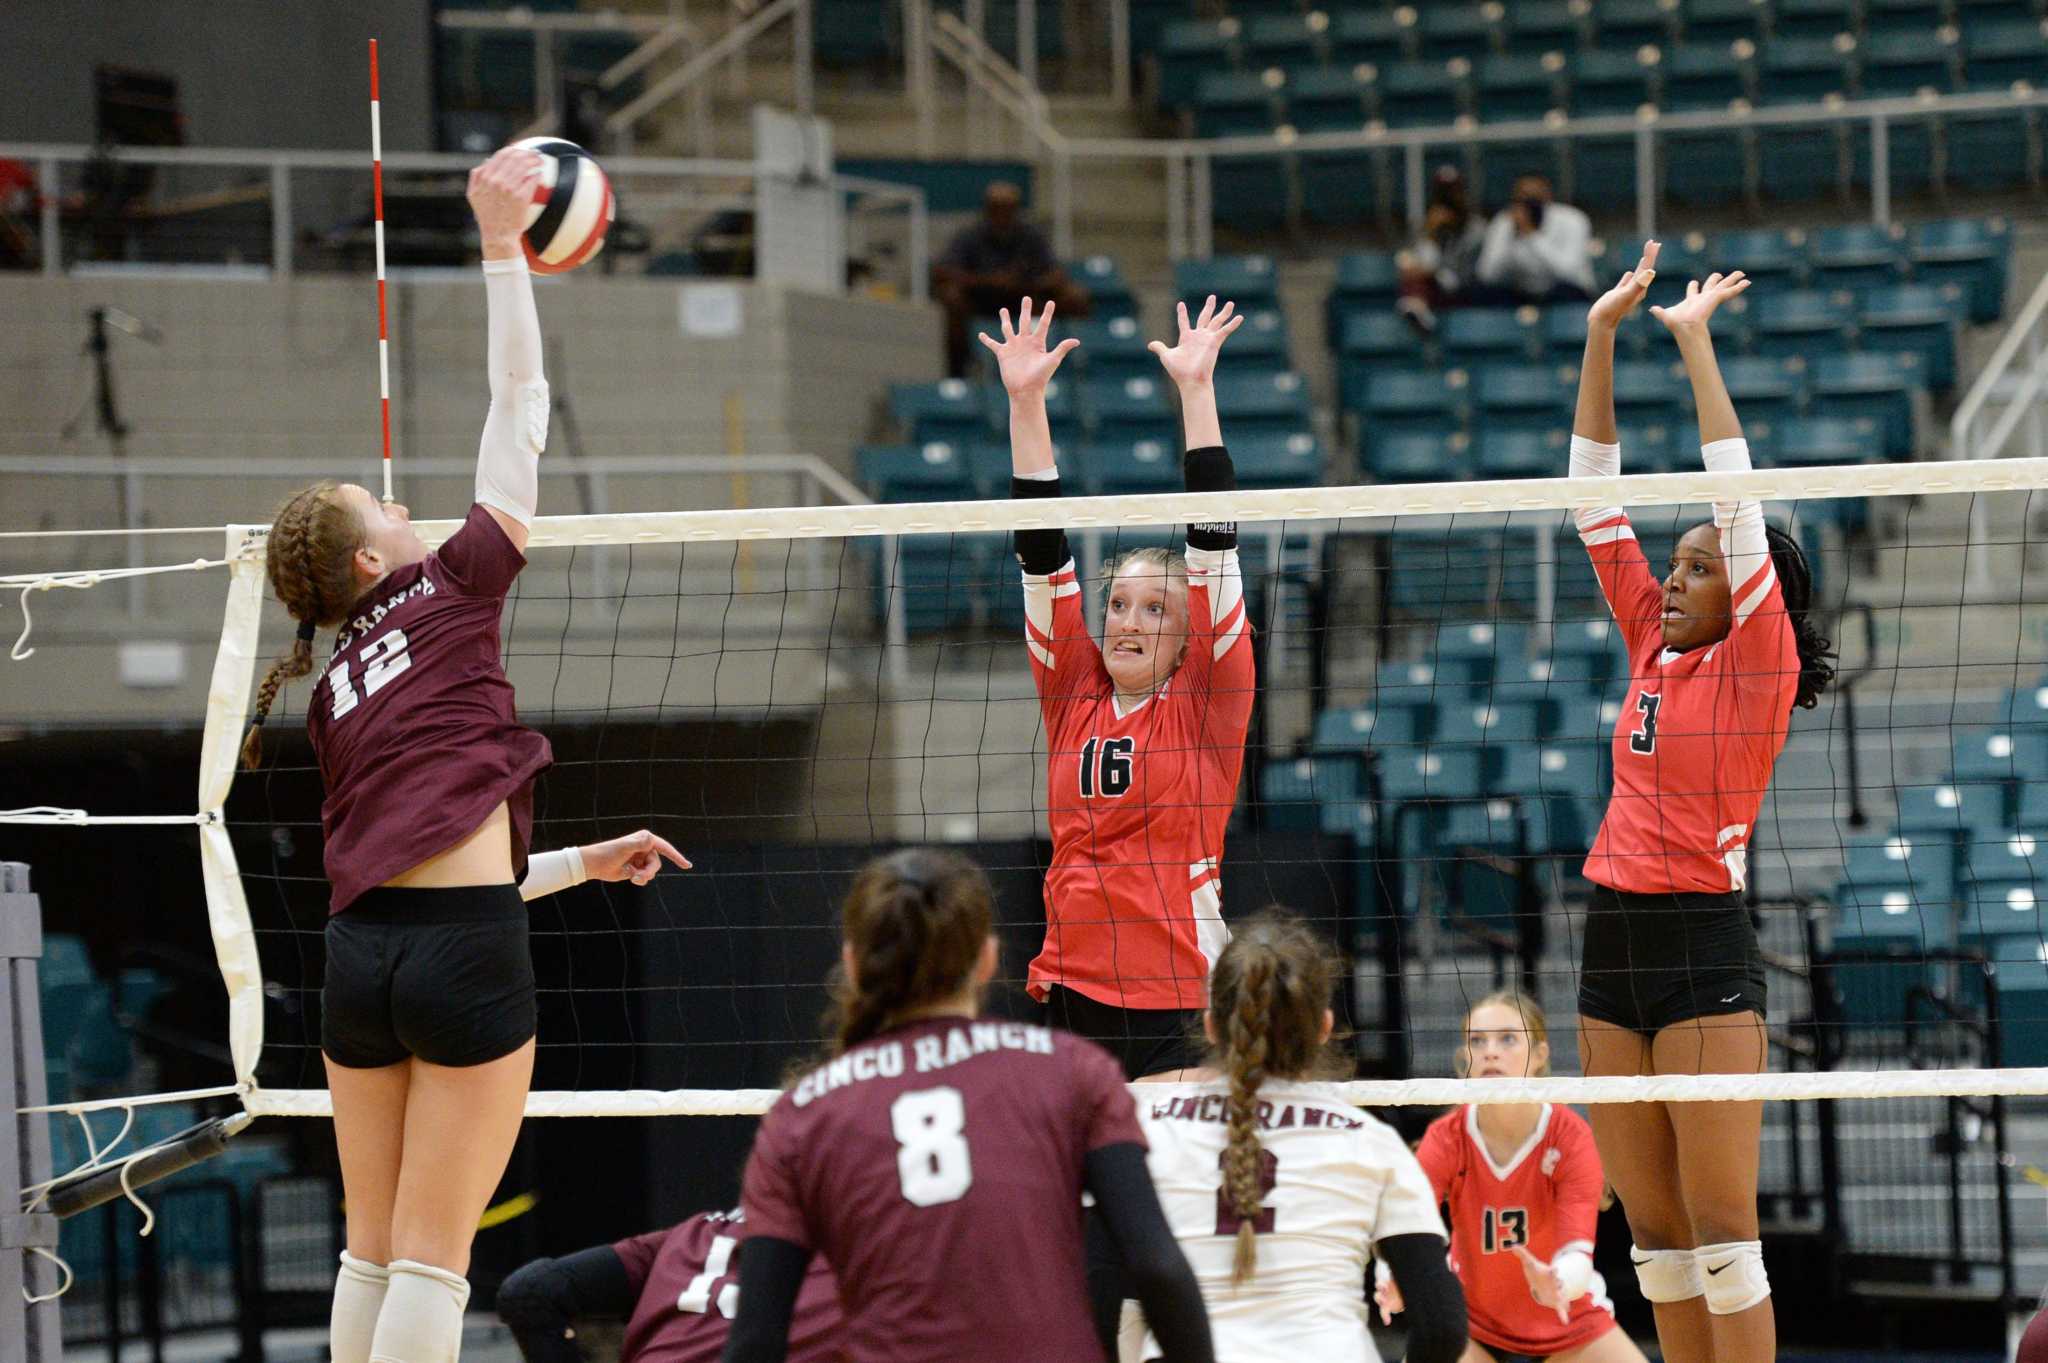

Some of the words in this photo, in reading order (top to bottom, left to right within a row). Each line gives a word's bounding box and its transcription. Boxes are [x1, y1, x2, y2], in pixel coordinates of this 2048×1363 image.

[328, 629, 412, 720] 12
[1630, 690, 1661, 755] 3
[1079, 736, 1135, 798] 16
[793, 1042, 904, 1107] CINCO
[914, 1022, 1053, 1072] RANCH
[891, 1086, 972, 1207] 8
[1482, 1207, 1528, 1255] 13
